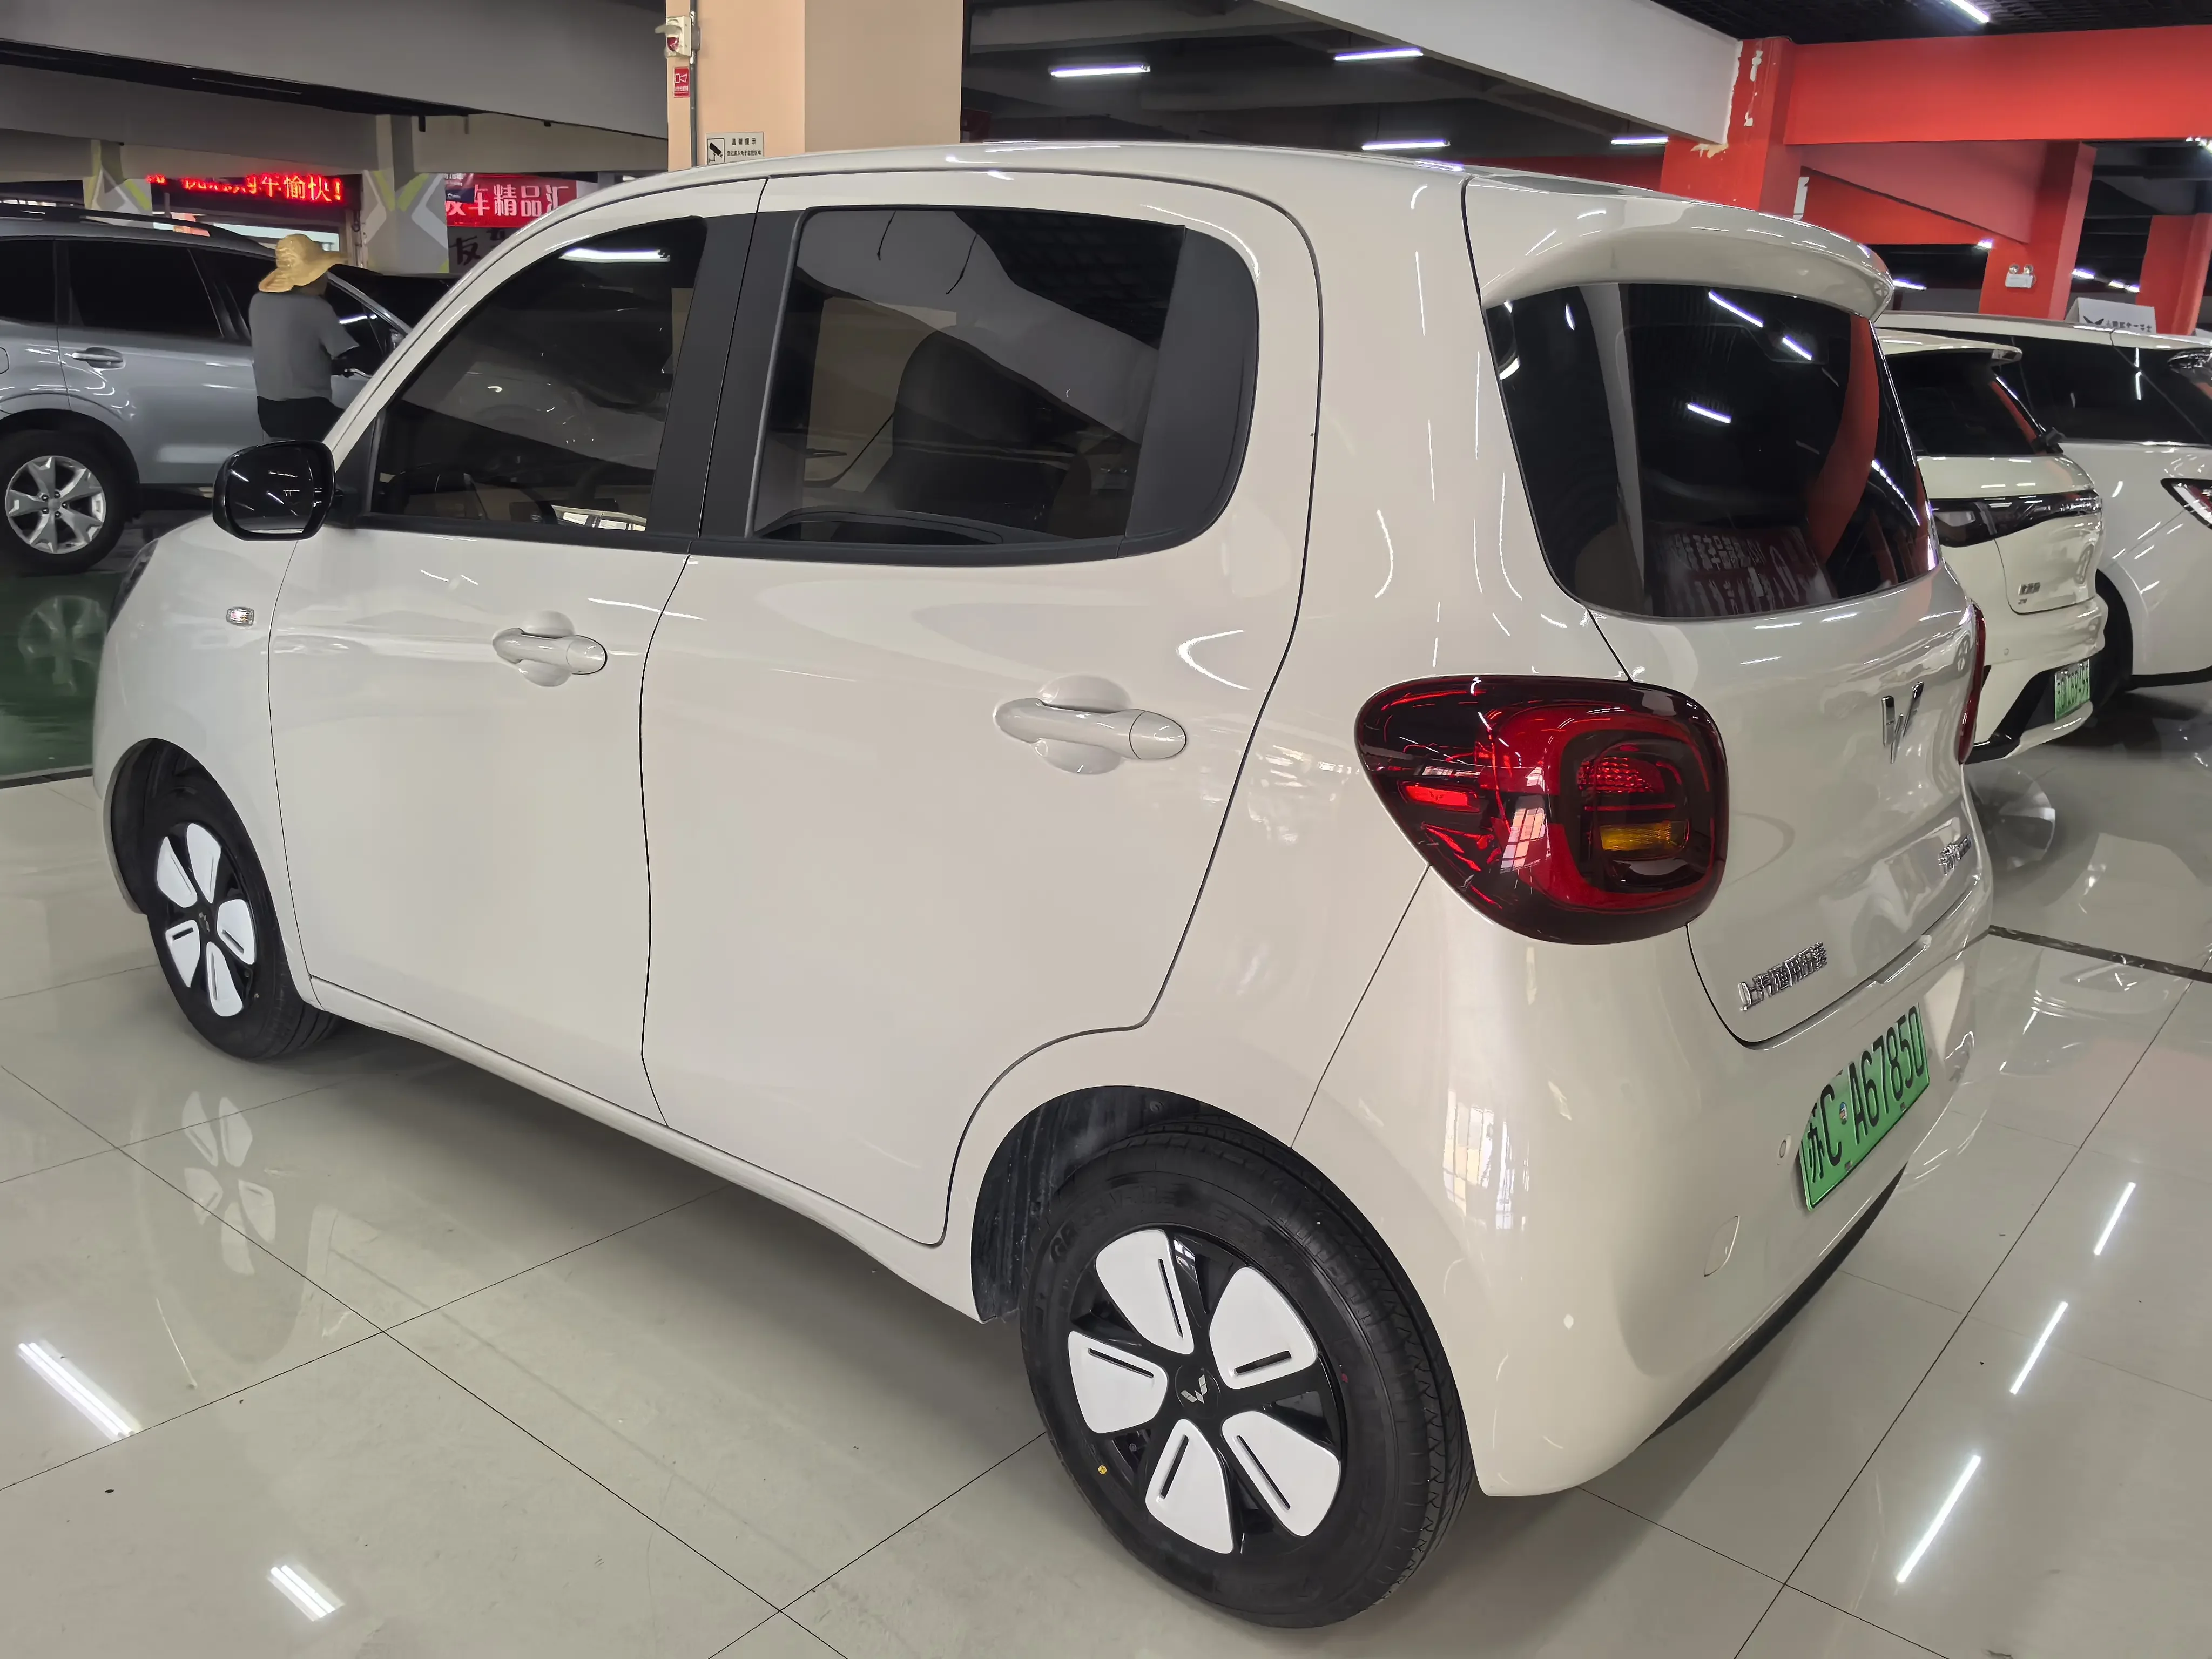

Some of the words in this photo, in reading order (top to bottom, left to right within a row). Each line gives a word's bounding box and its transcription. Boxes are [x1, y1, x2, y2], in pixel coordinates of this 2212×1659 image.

[1737, 941, 1828, 1012] 上汽通用五菱
